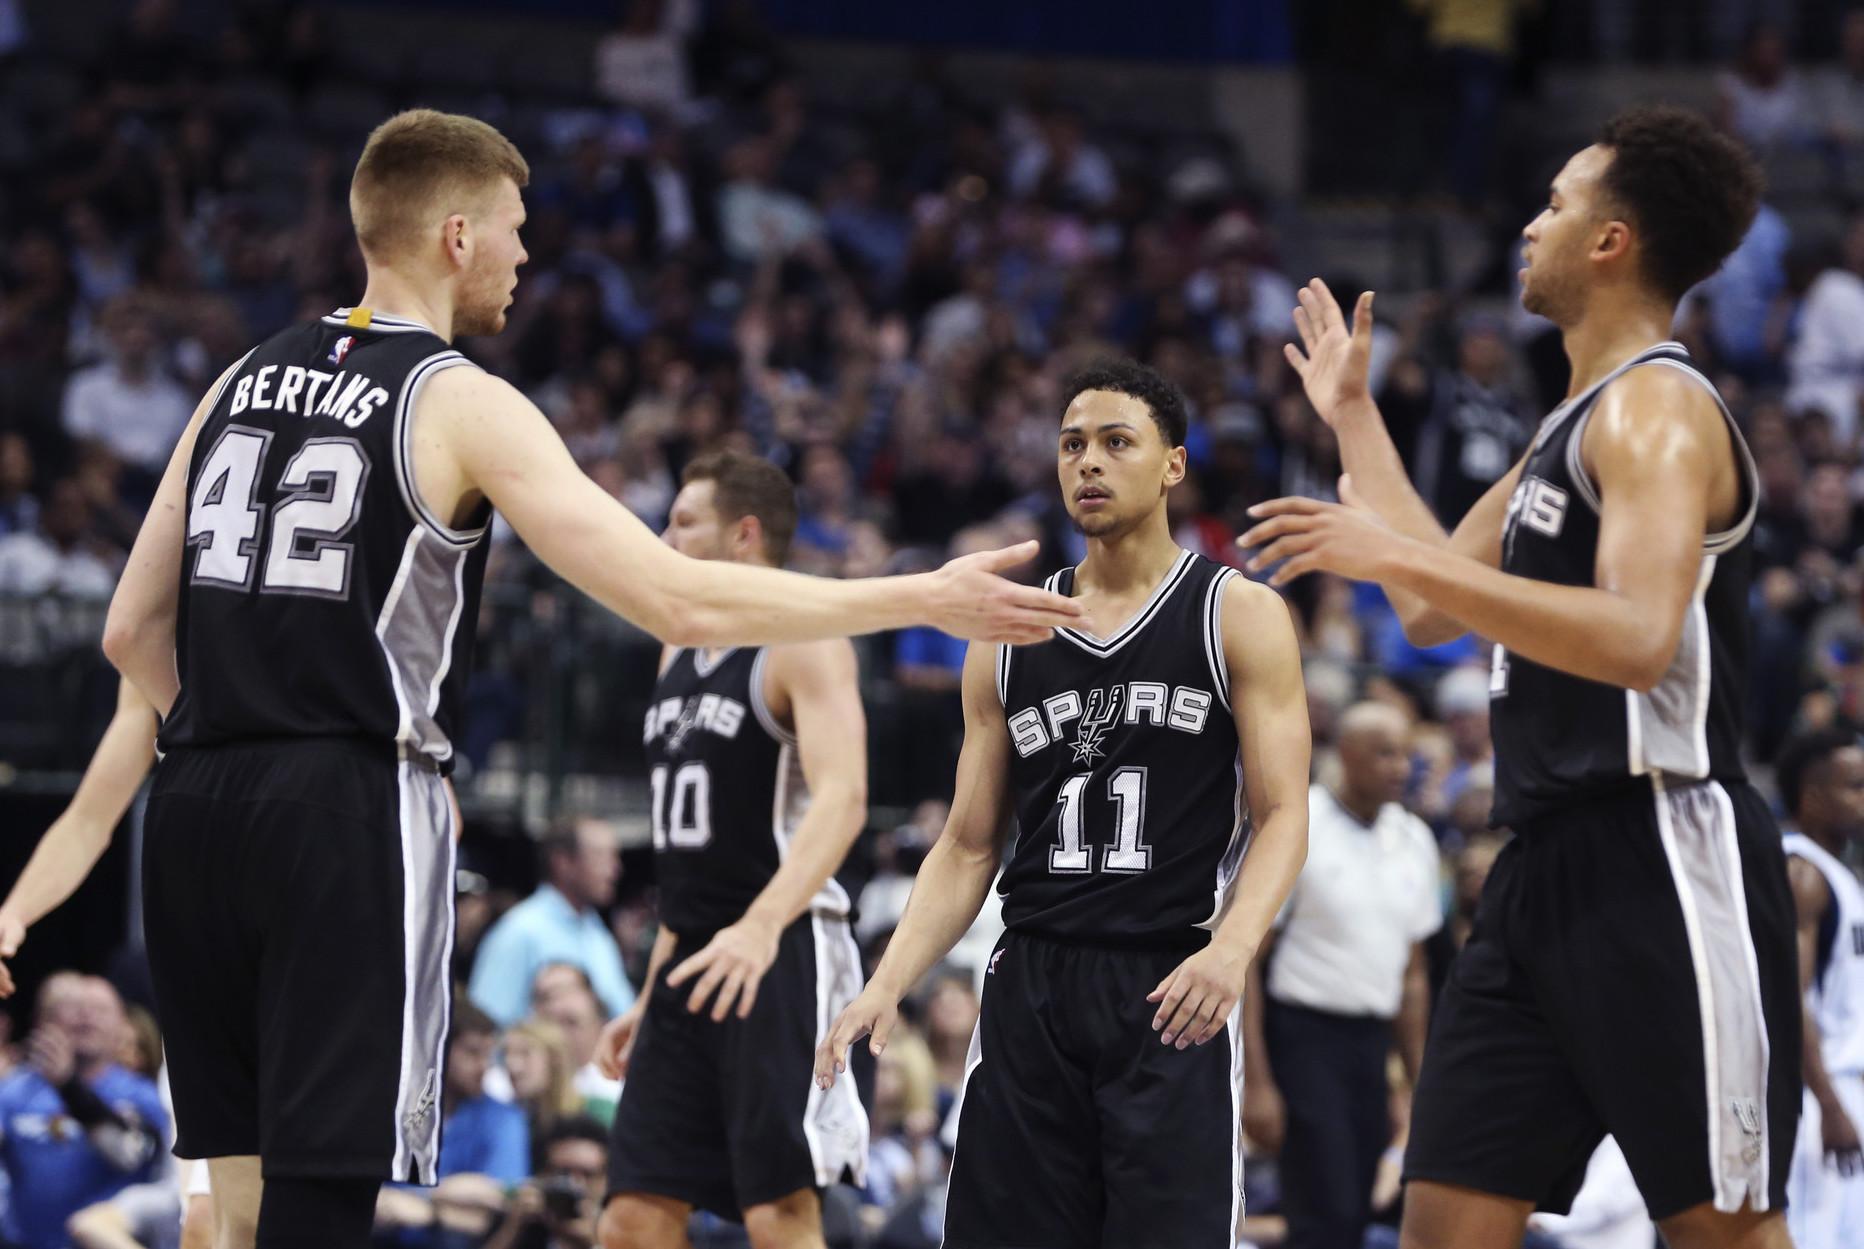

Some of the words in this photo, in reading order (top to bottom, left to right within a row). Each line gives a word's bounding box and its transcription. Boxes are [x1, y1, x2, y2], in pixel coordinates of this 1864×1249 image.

[229, 364, 390, 429] BERTANS
[186, 423, 373, 601] 42
[1007, 681, 1213, 767] SPURS
[650, 760, 713, 851] 10
[1048, 765, 1153, 874] 11
